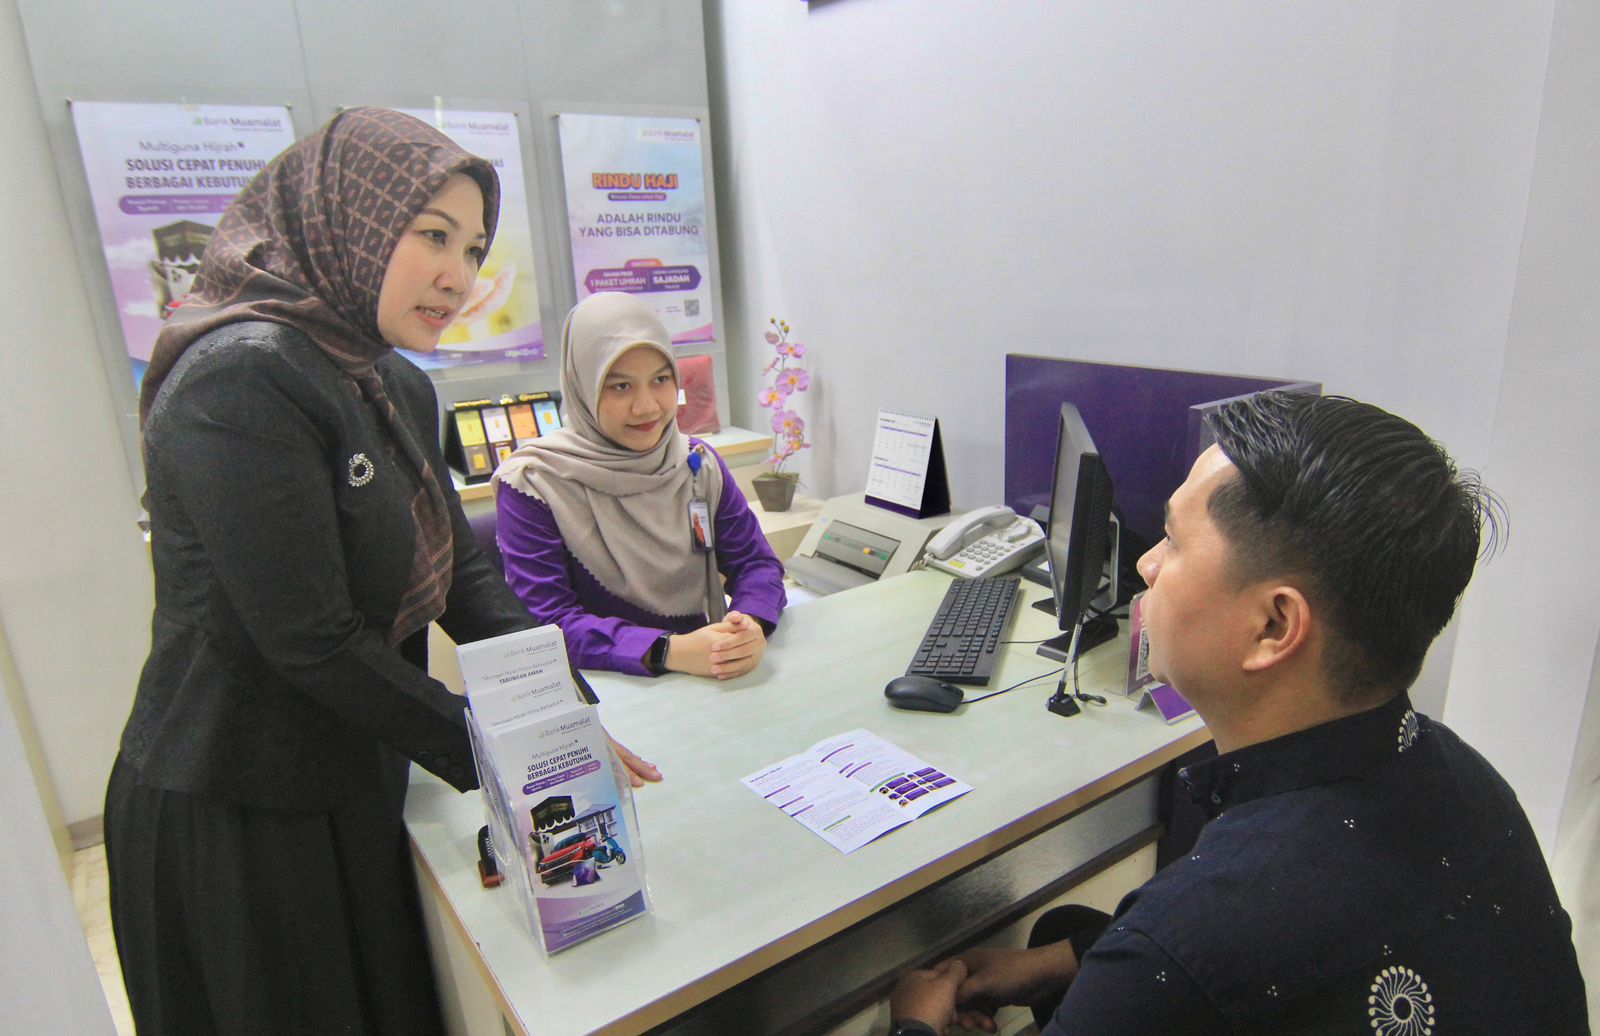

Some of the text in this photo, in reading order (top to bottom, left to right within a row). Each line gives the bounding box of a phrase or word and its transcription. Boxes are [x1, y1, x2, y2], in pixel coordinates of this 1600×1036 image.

[230, 117, 281, 127] Muamalat
[468, 122, 509, 131] Muamalat
[139, 141, 199, 154] Multiguna
[126, 159, 174, 171] SOLUSI
[177, 159, 216, 171] CEPAT
[126, 176, 193, 189] BERBAGAI
[592, 173, 678, 189] RINDU HAJI
[597, 213, 681, 224] ADALAH RINDU
[579, 225, 699, 237] YANG BISA DITABUNG
[595, 279, 619, 287] PAKET
[620, 277, 646, 286] UMRAH
[653, 275, 690, 284] SAJADAH
[526, 641, 557, 652] Muamalat
[531, 681, 561, 695] Muamalat
[560, 717, 591, 731] Muamalat
[528, 746, 589, 773] SOLUSI CEPAT PENUHI
[527, 766, 558, 781] BERBAGAI
[558, 753, 592, 770] KEBUTUHAN
